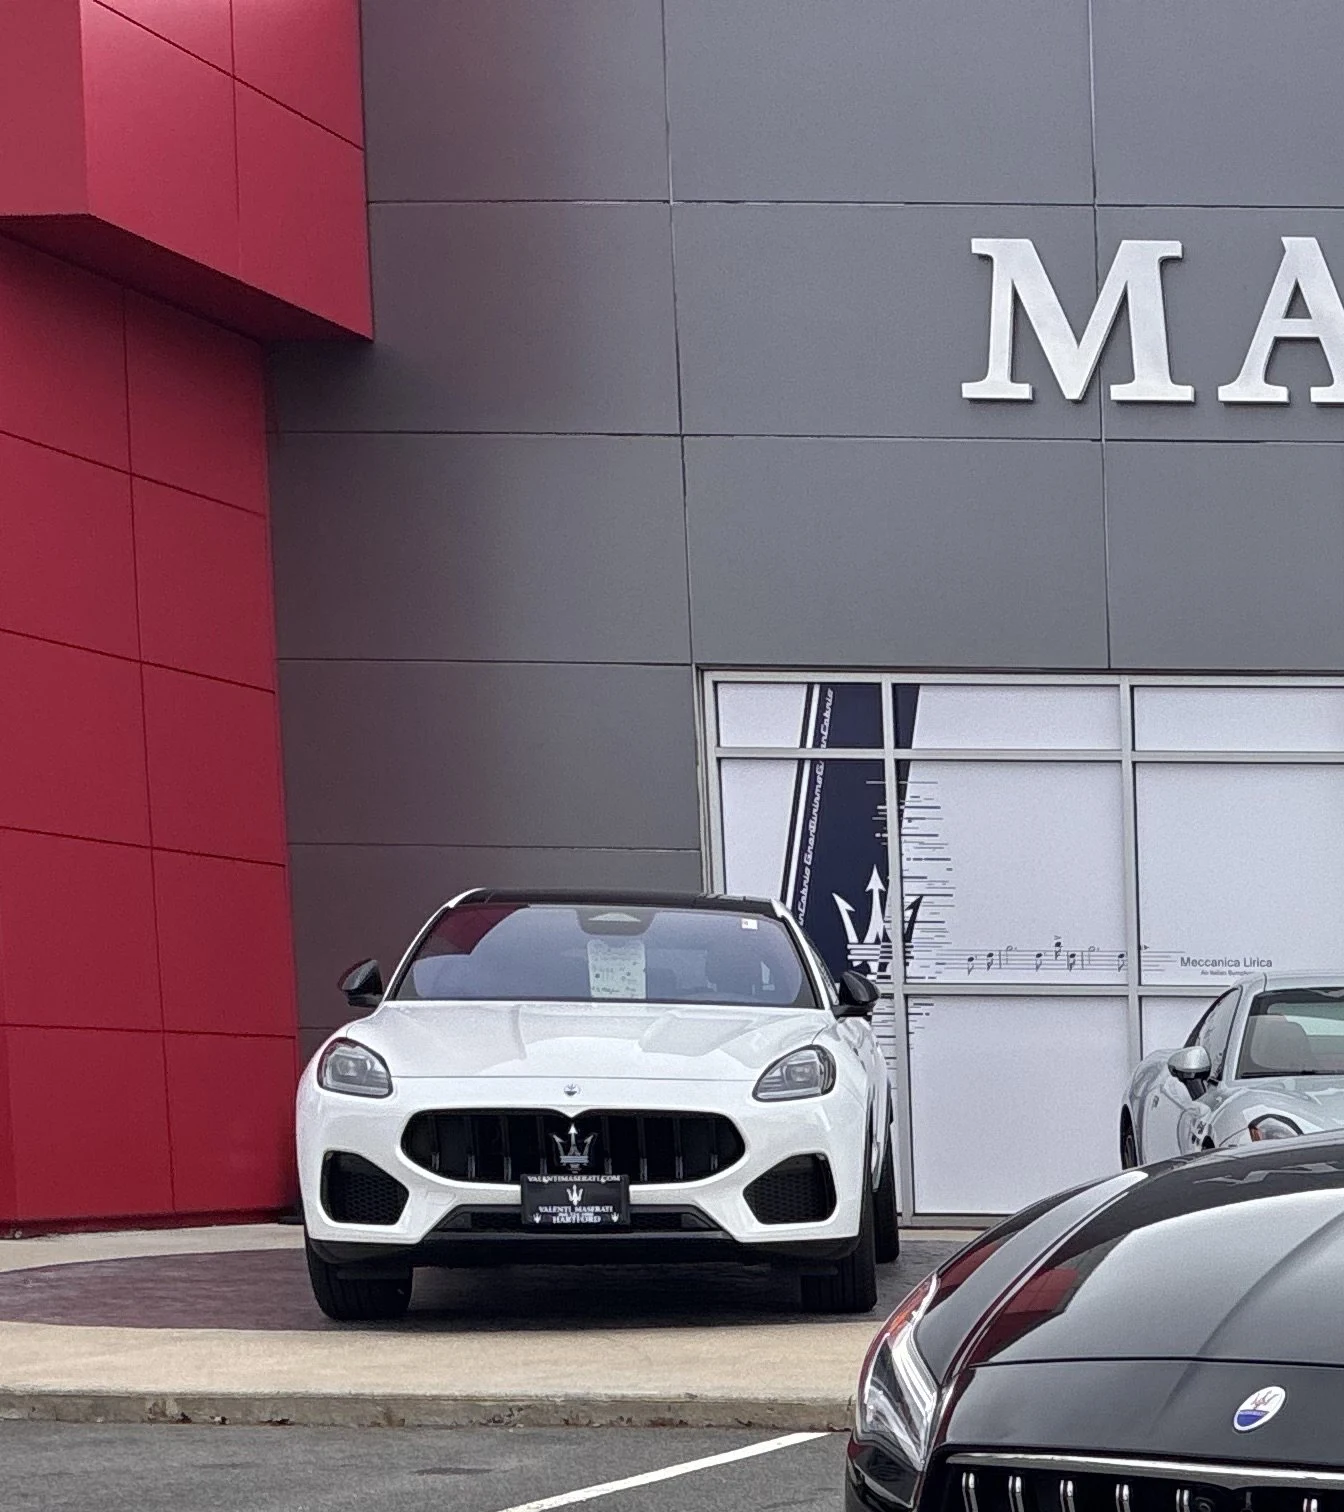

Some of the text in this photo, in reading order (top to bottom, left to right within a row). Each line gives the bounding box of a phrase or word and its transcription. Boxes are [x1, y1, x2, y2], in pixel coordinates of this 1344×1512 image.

[1180, 956, 1273, 968] Meccanica Lirica
[538, 1205, 614, 1214] VALENTI MASERATI
